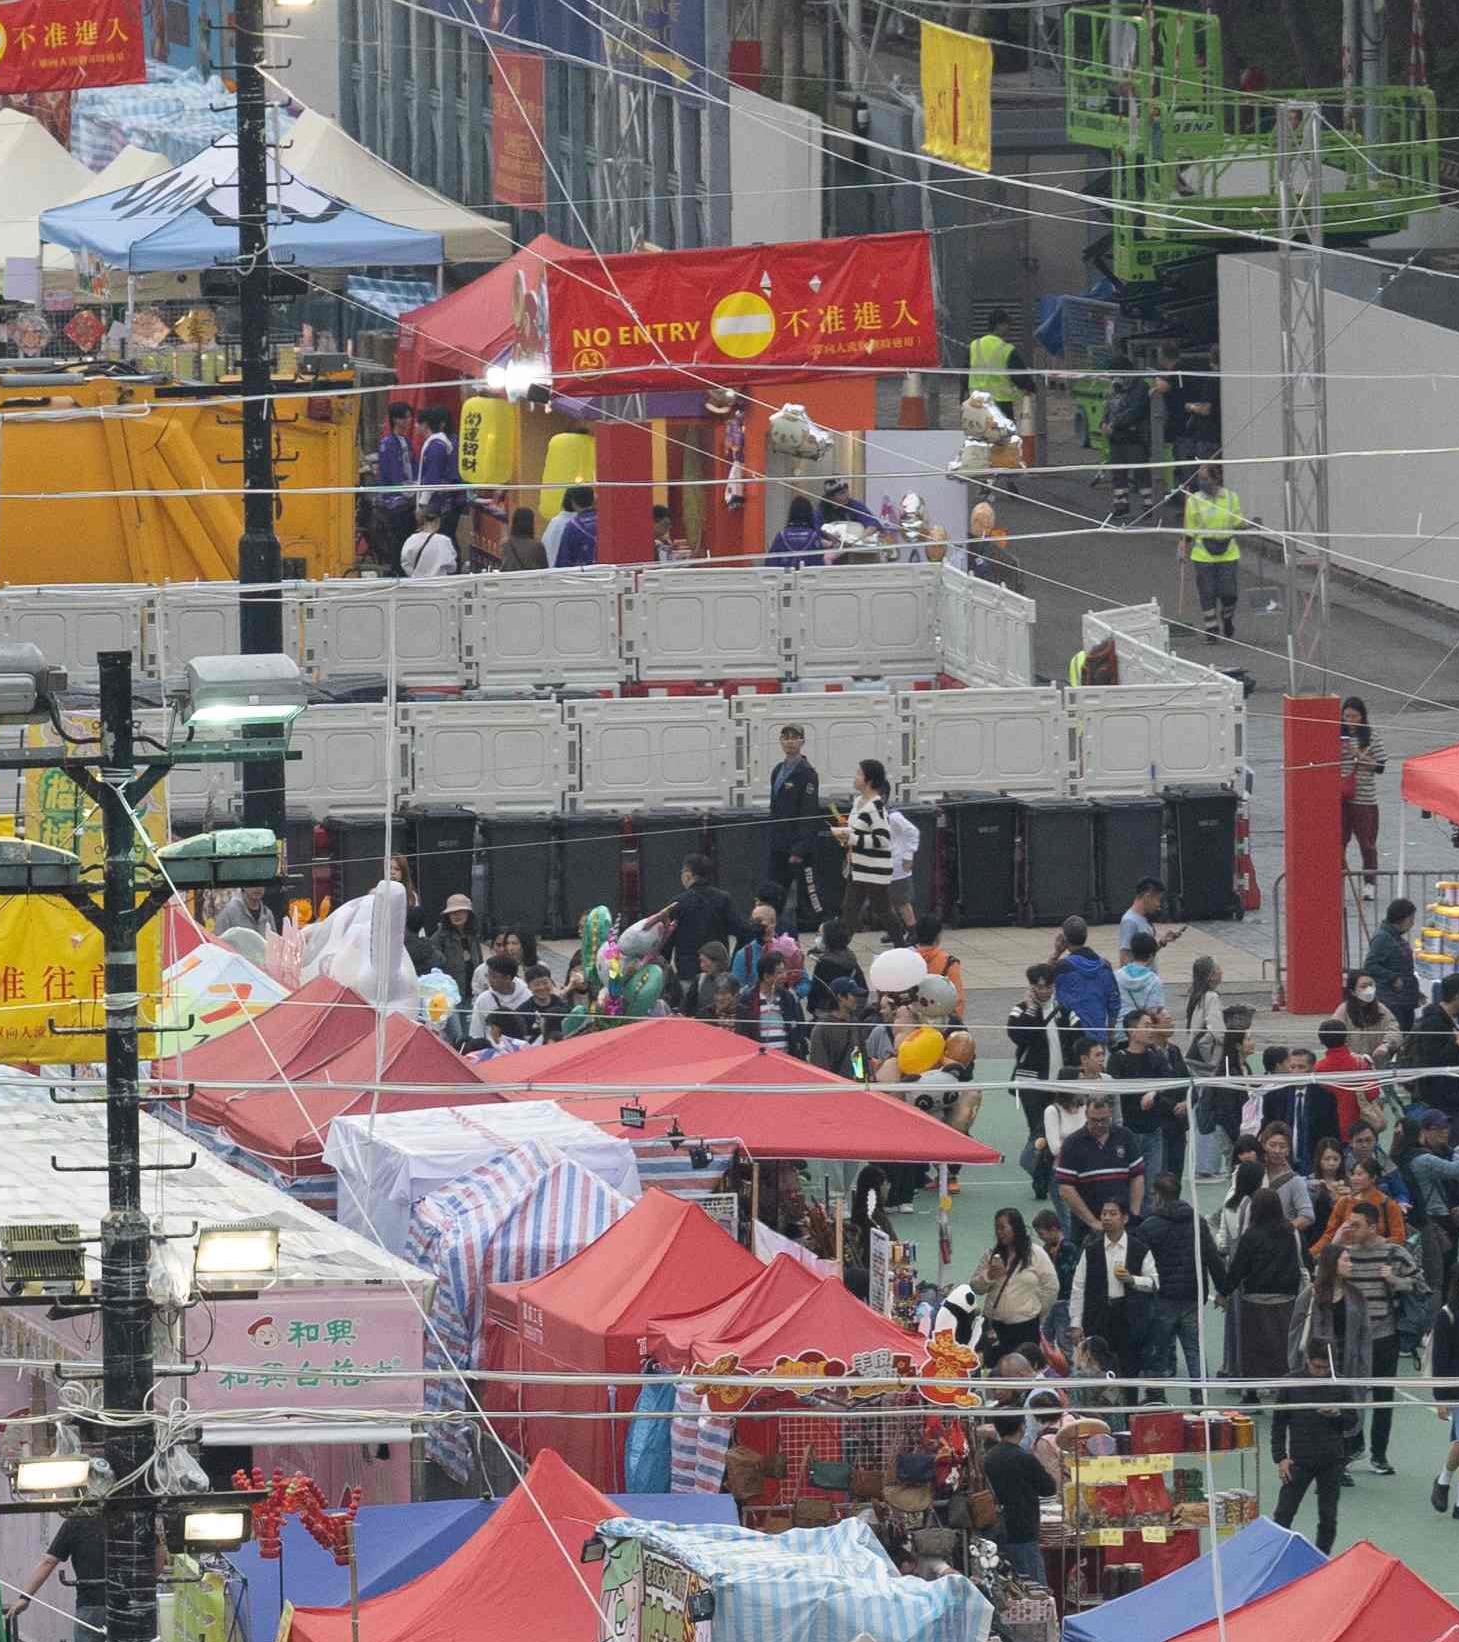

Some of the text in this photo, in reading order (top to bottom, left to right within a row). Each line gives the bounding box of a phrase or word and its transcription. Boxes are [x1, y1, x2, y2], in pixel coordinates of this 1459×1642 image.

[12, 15, 129, 50] 不准進入
[573, 320, 700, 348] NO ENTRY
[781, 299, 918, 337] 不准進入
[288, 1318, 357, 1348] 和興
